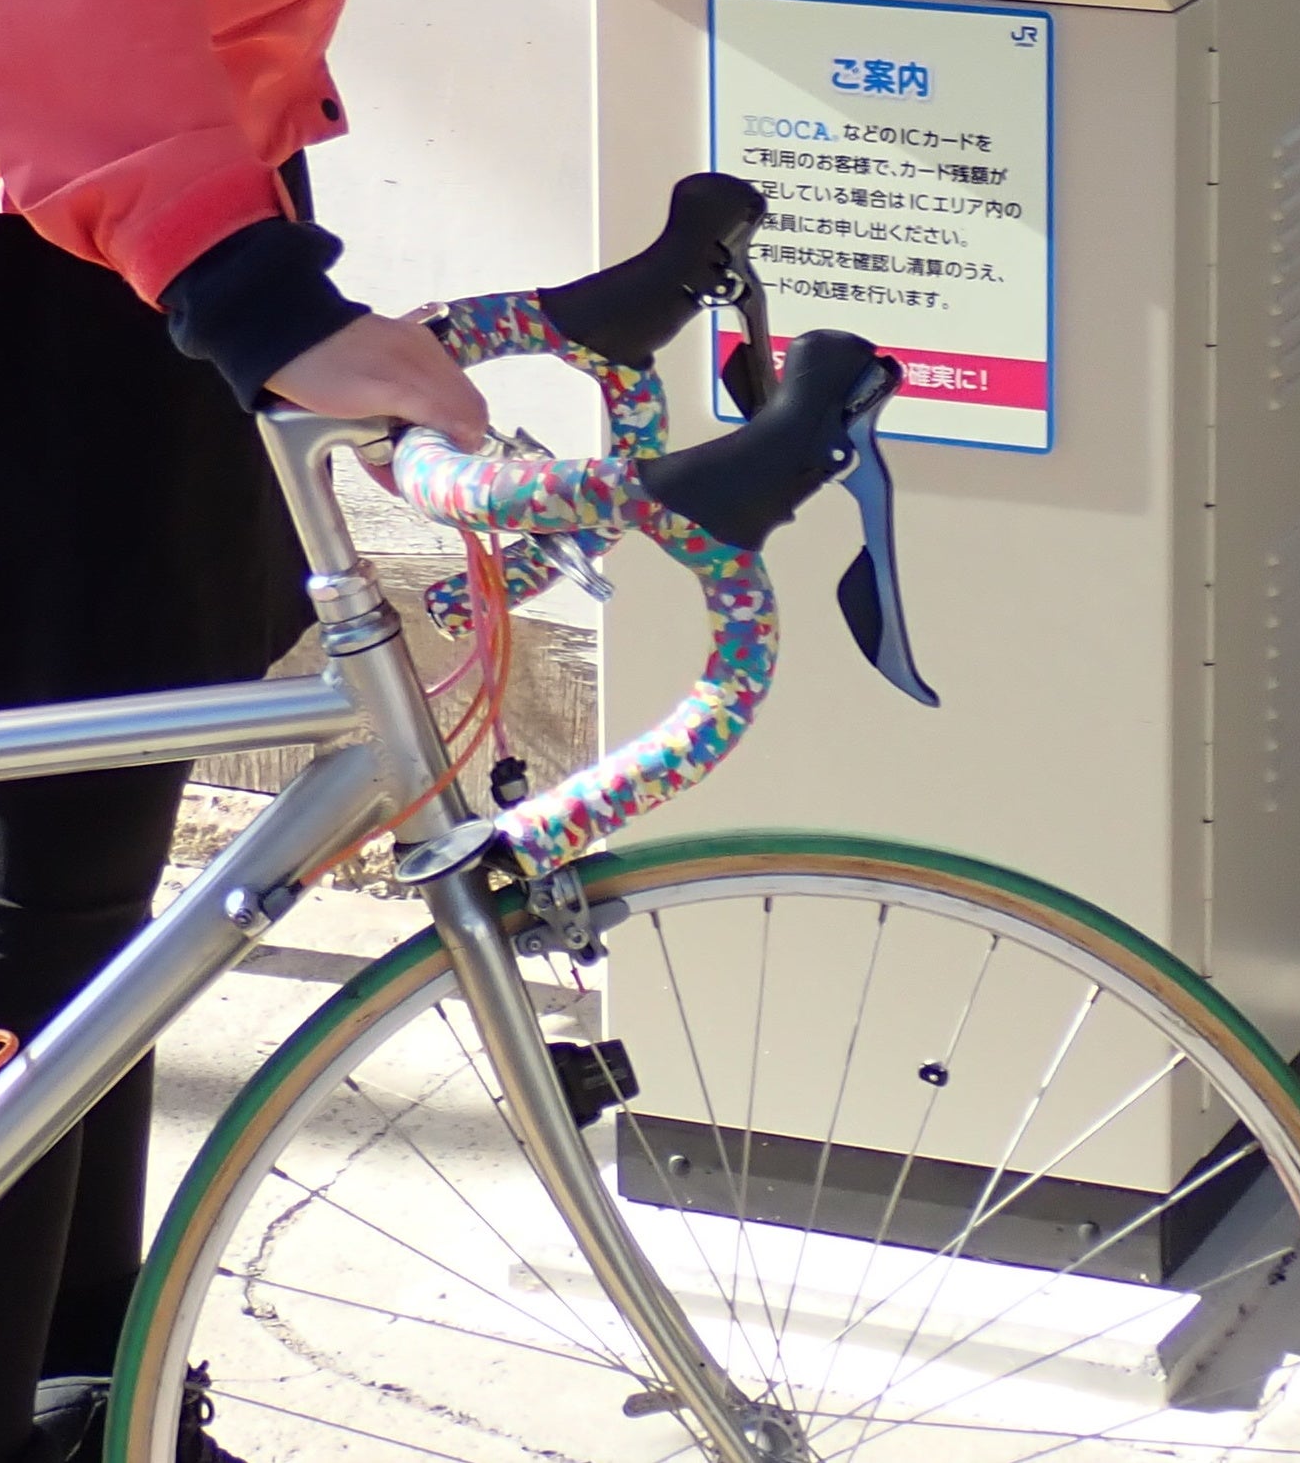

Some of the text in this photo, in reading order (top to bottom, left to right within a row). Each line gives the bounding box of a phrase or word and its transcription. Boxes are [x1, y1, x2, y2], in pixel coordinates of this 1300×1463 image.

[1010, 25, 1038, 43] JR
[831, 58, 929, 98] ご案内
[843, 123, 993, 152] などのICカードを
[741, 147, 1009, 186] ご利用のお客様で、カード残額が
[760, 212, 969, 248] 係員にお申し出ください。
[760, 276, 950, 311] ードの処理を行います。
[899, 359, 988, 391] 確実に!
